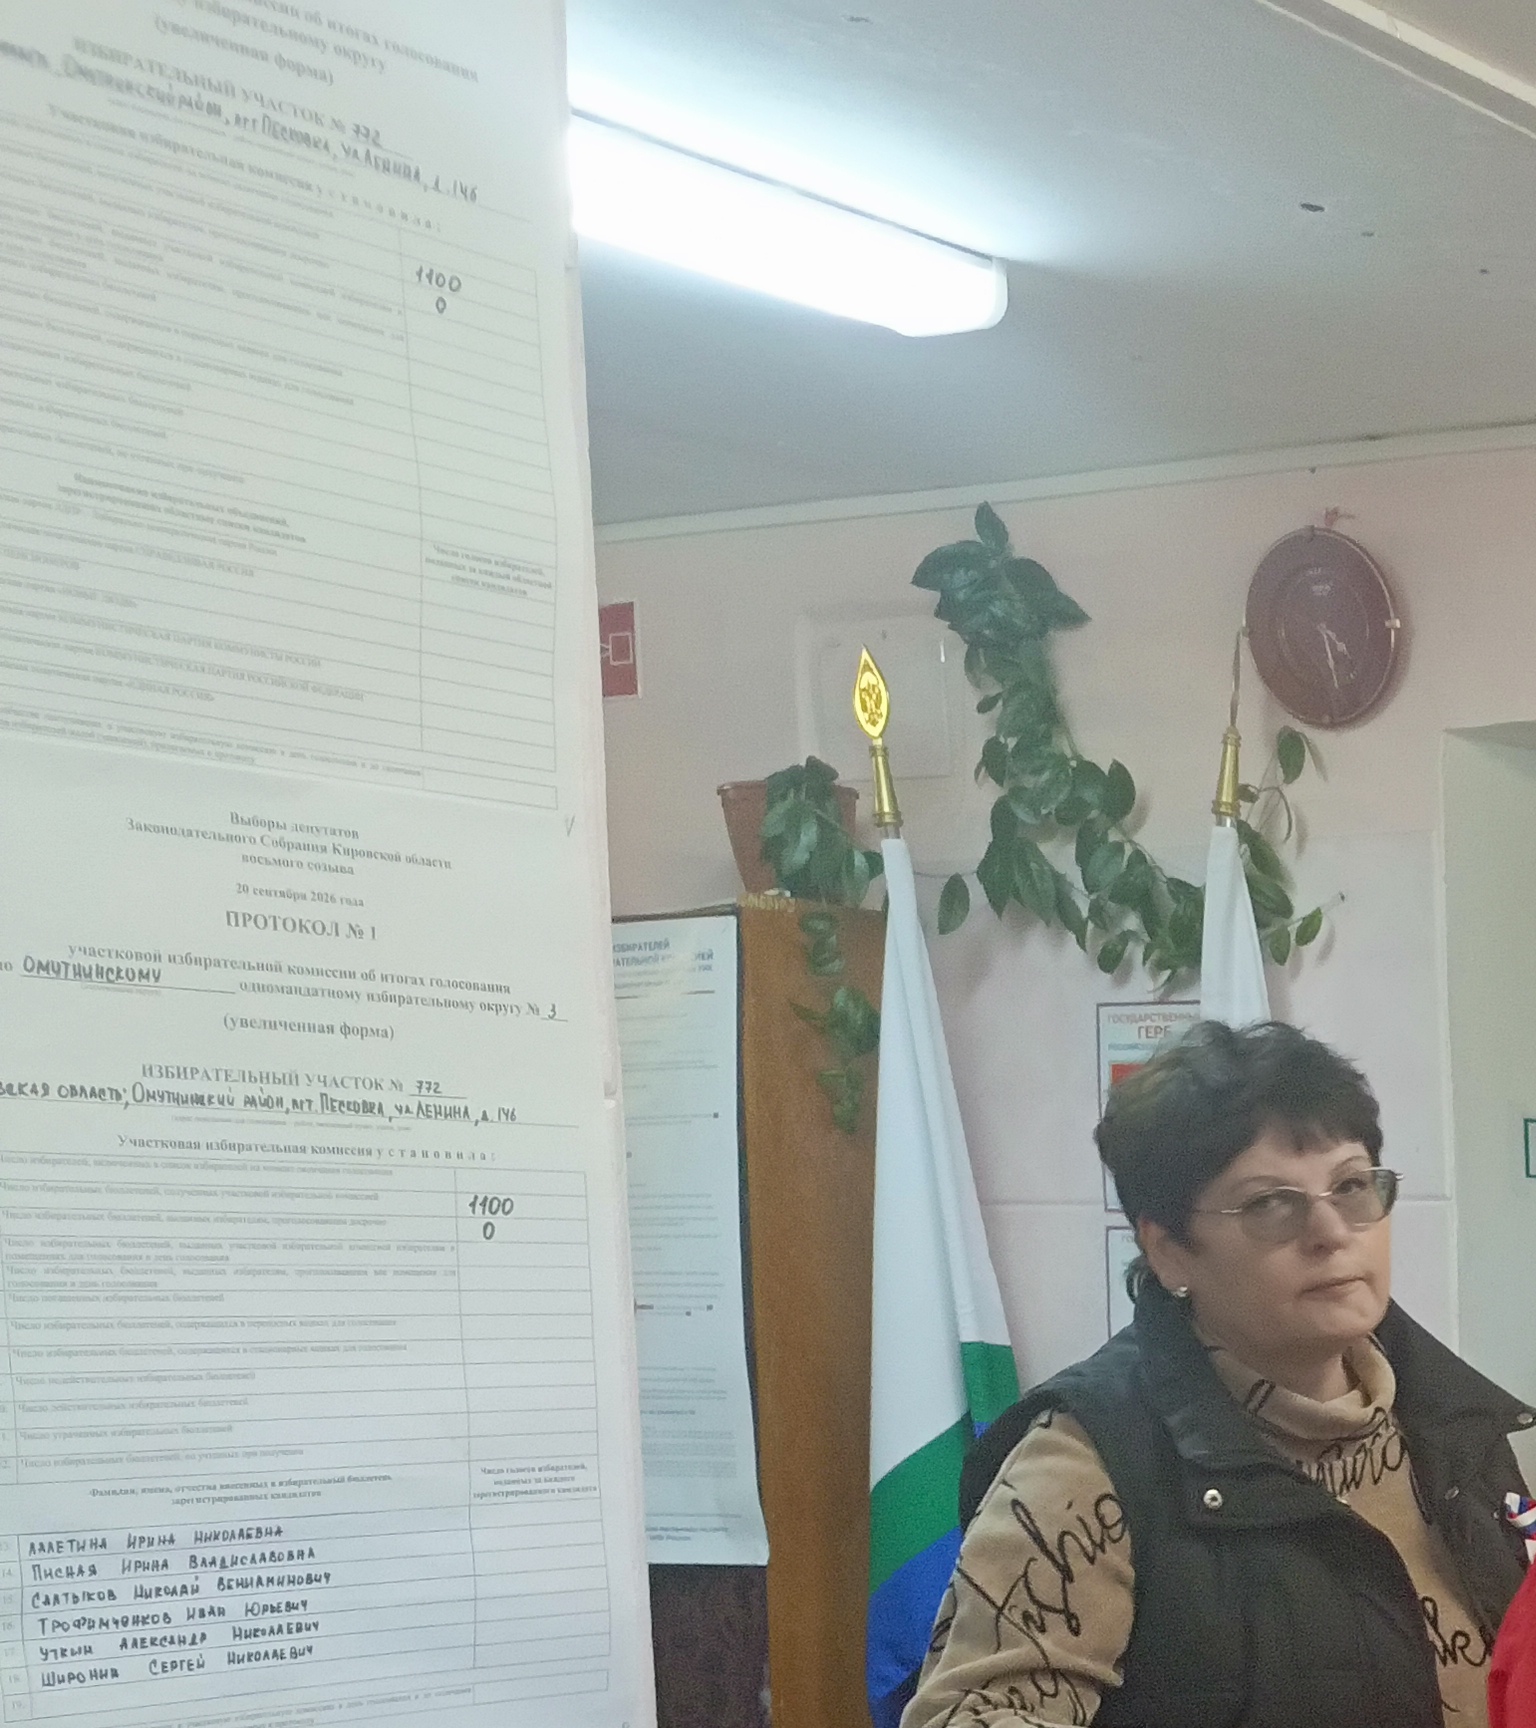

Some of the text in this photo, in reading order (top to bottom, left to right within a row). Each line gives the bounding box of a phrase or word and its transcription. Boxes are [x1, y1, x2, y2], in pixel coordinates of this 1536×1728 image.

[415, 264, 463, 295] 1100
[230, 811, 360, 840] Выборы депутатов
[125, 816, 453, 870] Законодательного Собрания Кировской области
[241, 853, 355, 876] восьмого созыва
[225, 910, 377, 941] ПРОТОКОЛ № 1
[68, 944, 512, 996] участковой избирательной комиссии об итогах голосования
[239, 980, 362, 1003] одномандатному
[366, 990, 476, 1012] избирательному
[479, 999, 523, 1017] округу
[223, 1013, 395, 1042] (увеличенная форма)
[142, 1063, 300, 1087] ИЗБИРАТЕЛЬНЫЙ
[304, 1072, 386, 1092] УЧАСТОК
[415, 1080, 442, 1094] 772
[117, 1133, 373, 1158] Участковая избирательная комиссия
[467, 1194, 515, 1217] 1100
[482, 1221, 496, 1241] 0
[126, 1532, 176, 1550] ИРИНА
